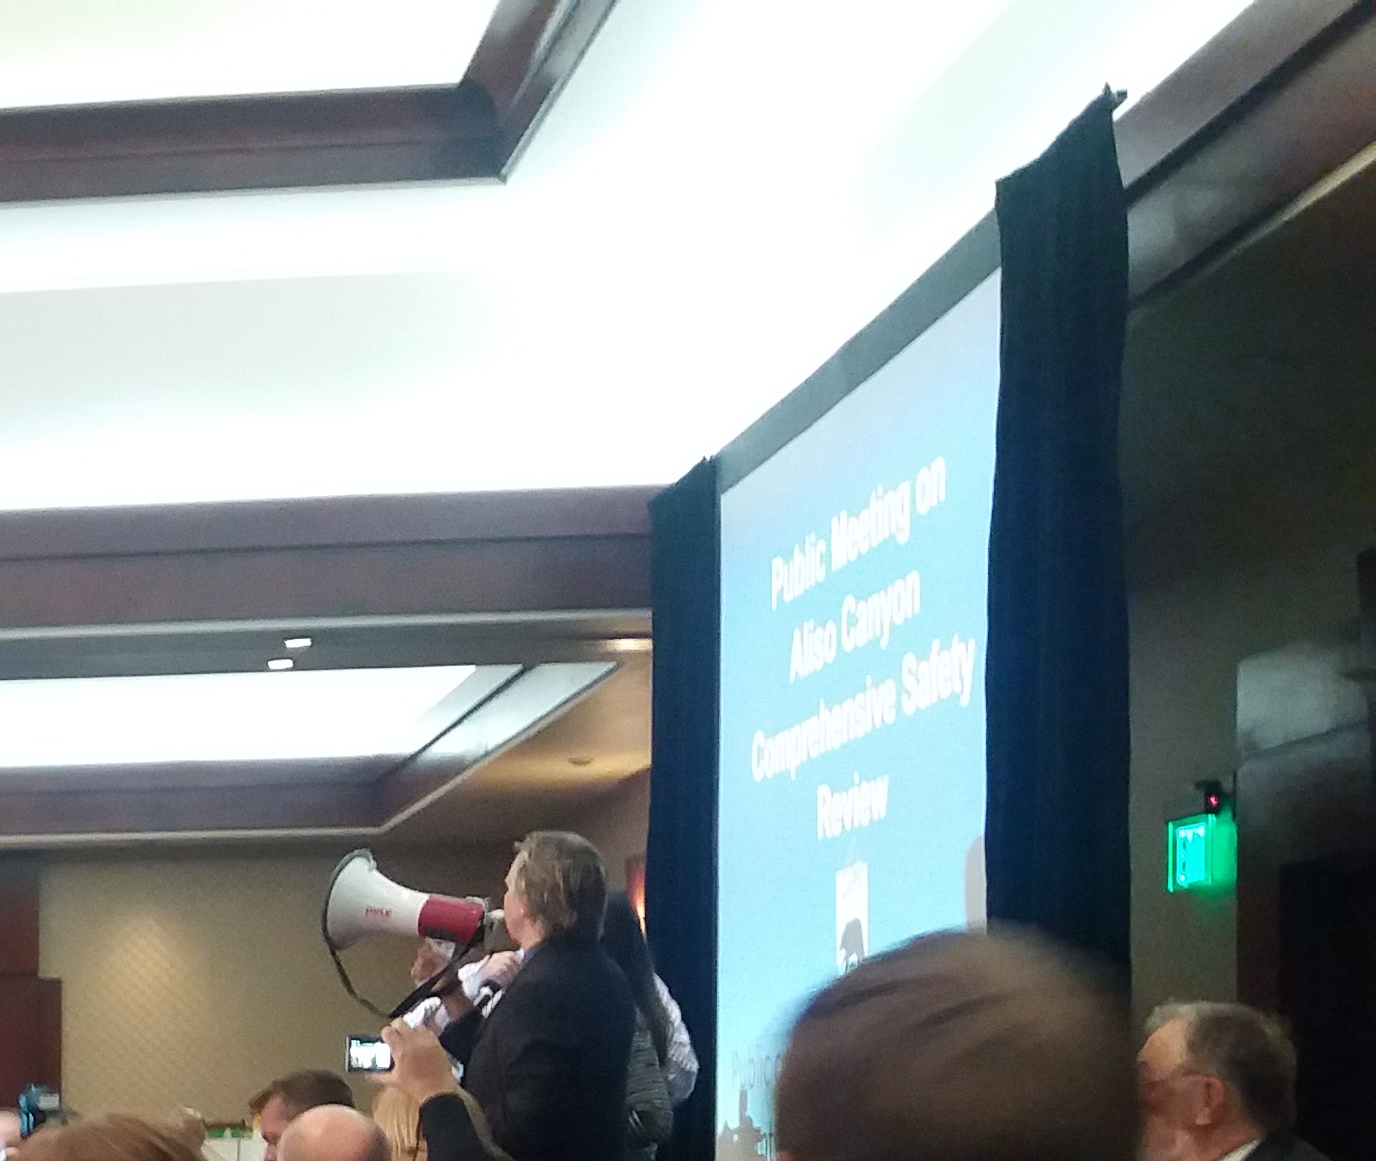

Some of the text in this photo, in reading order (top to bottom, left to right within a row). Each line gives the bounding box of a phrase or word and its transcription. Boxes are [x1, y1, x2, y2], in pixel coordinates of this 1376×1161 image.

[771, 456, 946, 612] Public Meeting on
[790, 570, 920, 684] Aliso Canyon
[752, 632, 976, 783] Comprehensive Safety
[817, 771, 889, 841] Review
